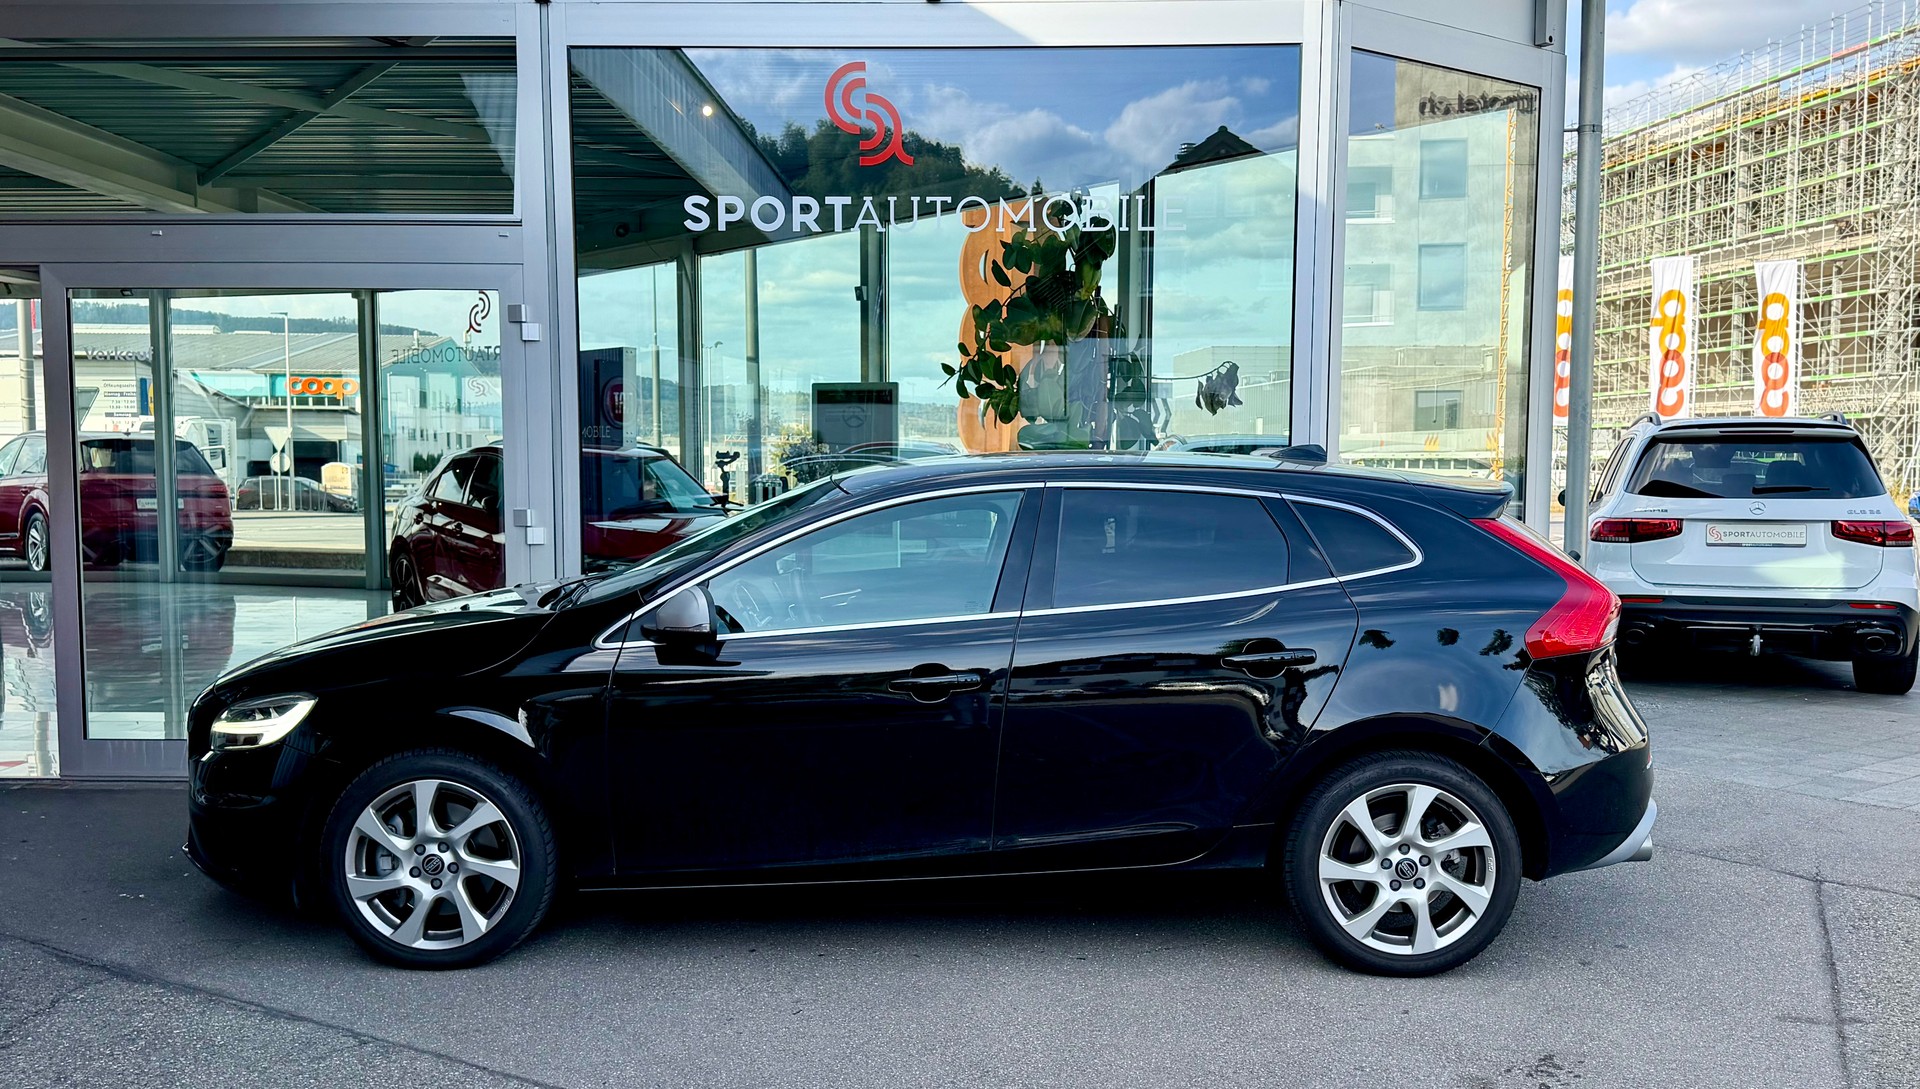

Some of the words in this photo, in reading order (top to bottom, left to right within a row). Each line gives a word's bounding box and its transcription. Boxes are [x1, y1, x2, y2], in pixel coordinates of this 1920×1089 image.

[683, 195, 1187, 233] SPORTAUTOMOBILE
[1650, 289, 1687, 417] coop
[1757, 292, 1790, 417] coop
[285, 376, 359, 400] coop
[1722, 531, 1805, 539] SPORTAUTOMOBILE
